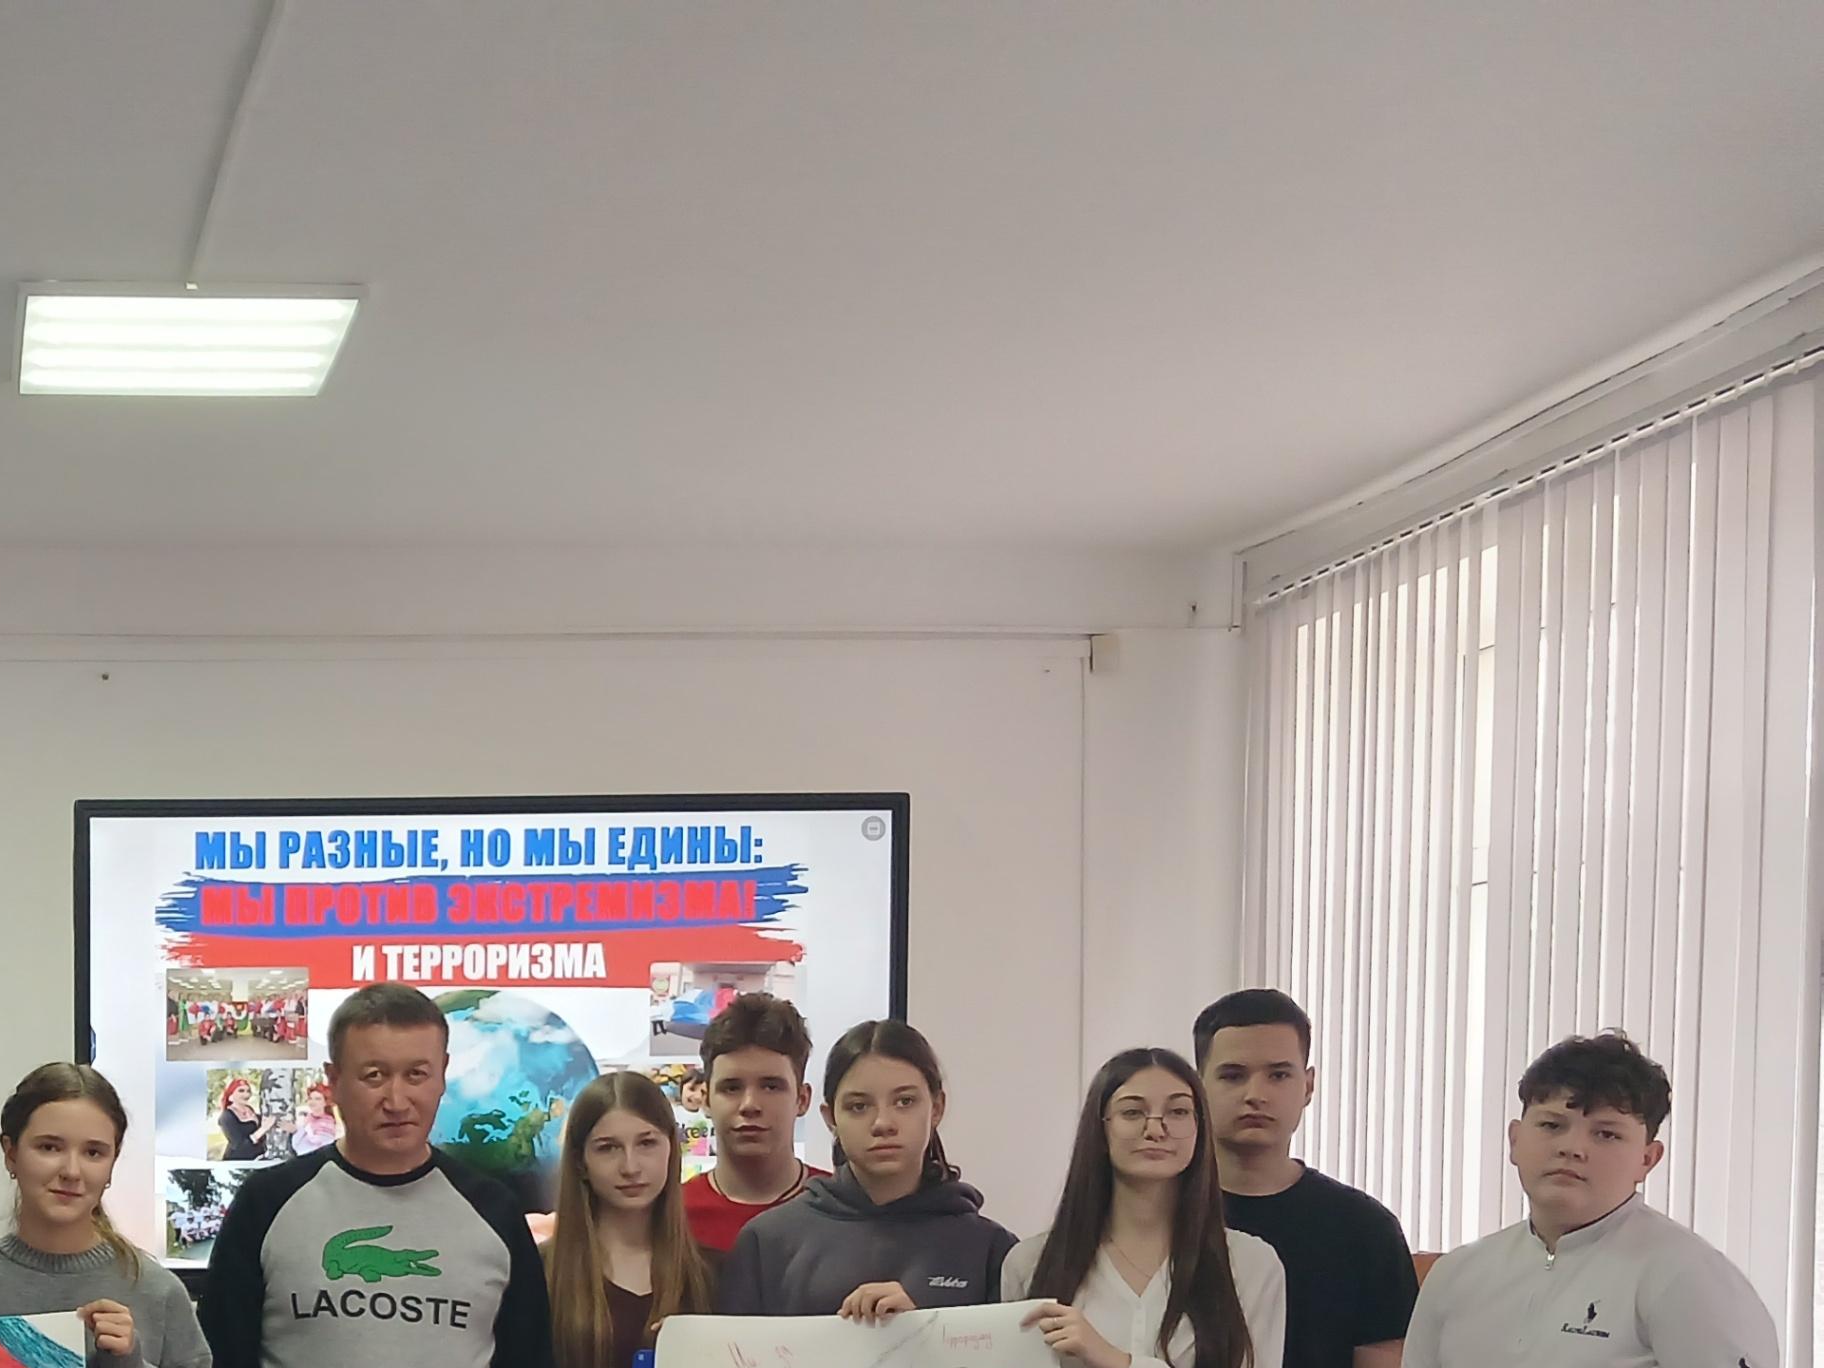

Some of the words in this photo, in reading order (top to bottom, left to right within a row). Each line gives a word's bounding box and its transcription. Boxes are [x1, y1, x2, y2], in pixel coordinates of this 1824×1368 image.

[194, 831, 266, 870] МЫ
[278, 829, 449, 871] РАЗНЫЕ,
[460, 828, 511, 867] НО
[523, 827, 596, 866] МЫ
[608, 826, 763, 870] ЕДИНЫ:
[201, 884, 275, 926] МЫ
[284, 883, 439, 926] ПРОТИВ
[352, 945, 376, 982] И
[381, 943, 607, 981] ТЕРРОРИЗМА
[291, 1289, 471, 1329] LACOSTE
